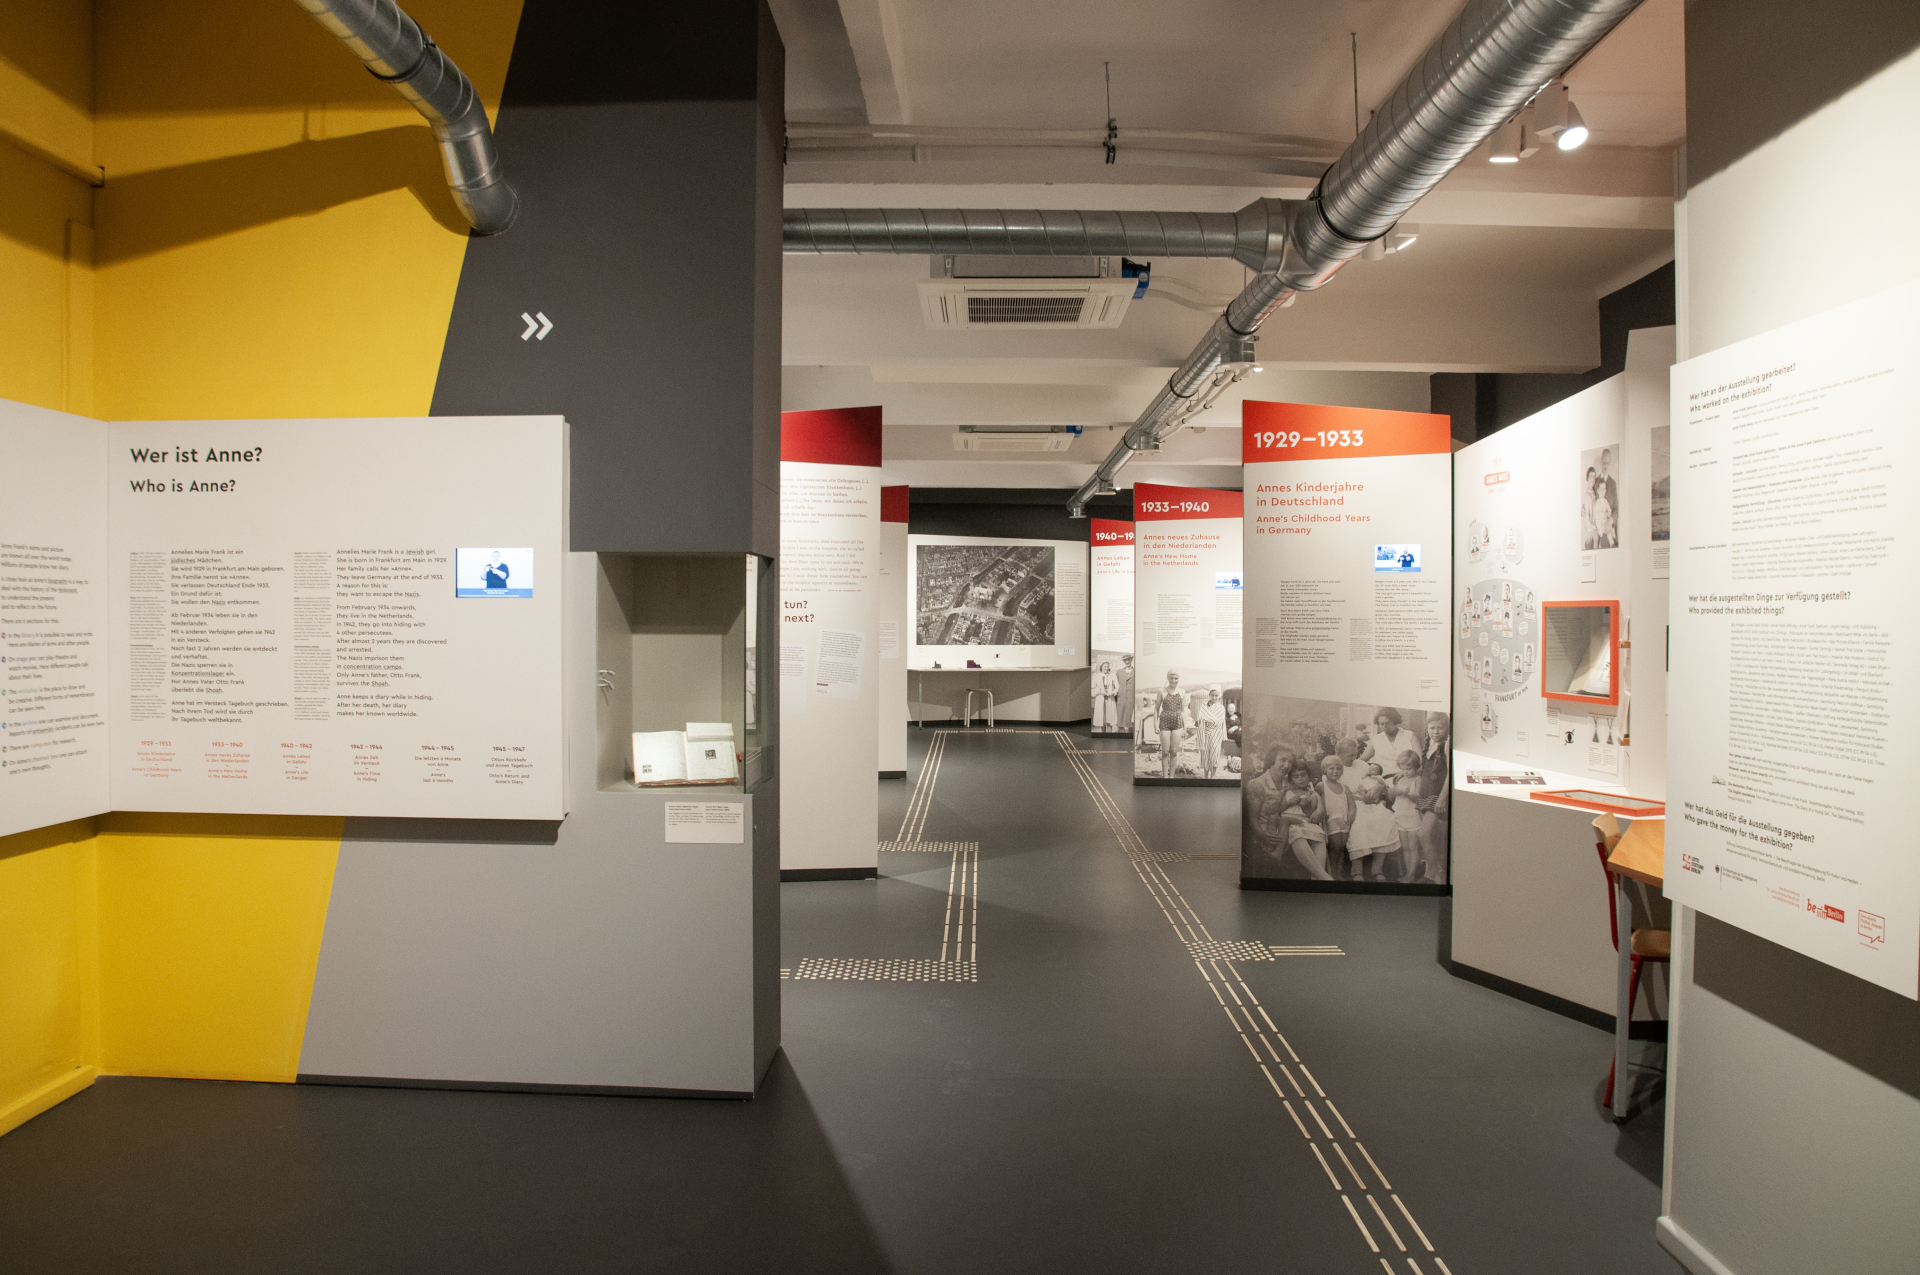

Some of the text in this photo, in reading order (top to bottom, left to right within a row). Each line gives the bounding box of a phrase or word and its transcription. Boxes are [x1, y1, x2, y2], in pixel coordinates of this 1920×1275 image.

[1718, 384, 1726, 393] der
[1728, 375, 1759, 390] Ausstellung
[1762, 363, 1796, 382] gearbeitet?
[1702, 398, 1721, 409] worked
[1731, 393, 1739, 401] the
[1741, 383, 1772, 398] exhibition?
[130, 446, 262, 463] Wer ist Anne?
[130, 479, 235, 492] Who is Anne?
[1257, 482, 1363, 493] Annes Kinderjahre
[1257, 496, 1343, 506] in Deutschland
[1291, 514, 1340, 522] Childhood
[1268, 526, 1311, 535] Germany
[1719, 593, 1754, 603] ausgestellten
[1756, 593, 1773, 602] Dinge
[1786, 592, 1818, 602] Verfügung
[1821, 591, 1850, 602] gestellt?
[1701, 606, 1723, 615] provided
[1735, 606, 1761, 614] exhibited
[1763, 606, 1784, 616] things?
[785, 614, 814, 622] next?
[1685, 801, 1694, 810] Wer
[1705, 806, 1714, 815] das
[1715, 810, 1727, 819] Geld
[1738, 815, 1746, 824] die
[1749, 819, 1782, 835] Ausstellung
[1784, 828, 1814, 843] gegeben?
[1684, 813, 1695, 822] Who
[1697, 818, 1708, 826] gave
[1710, 820, 1718, 829] the
[1720, 824, 1737, 836] money
[1749, 831, 1758, 841] the
[1760, 835, 1792, 850] exhibition?
[1807, 899, 1843, 920] be Berlin
